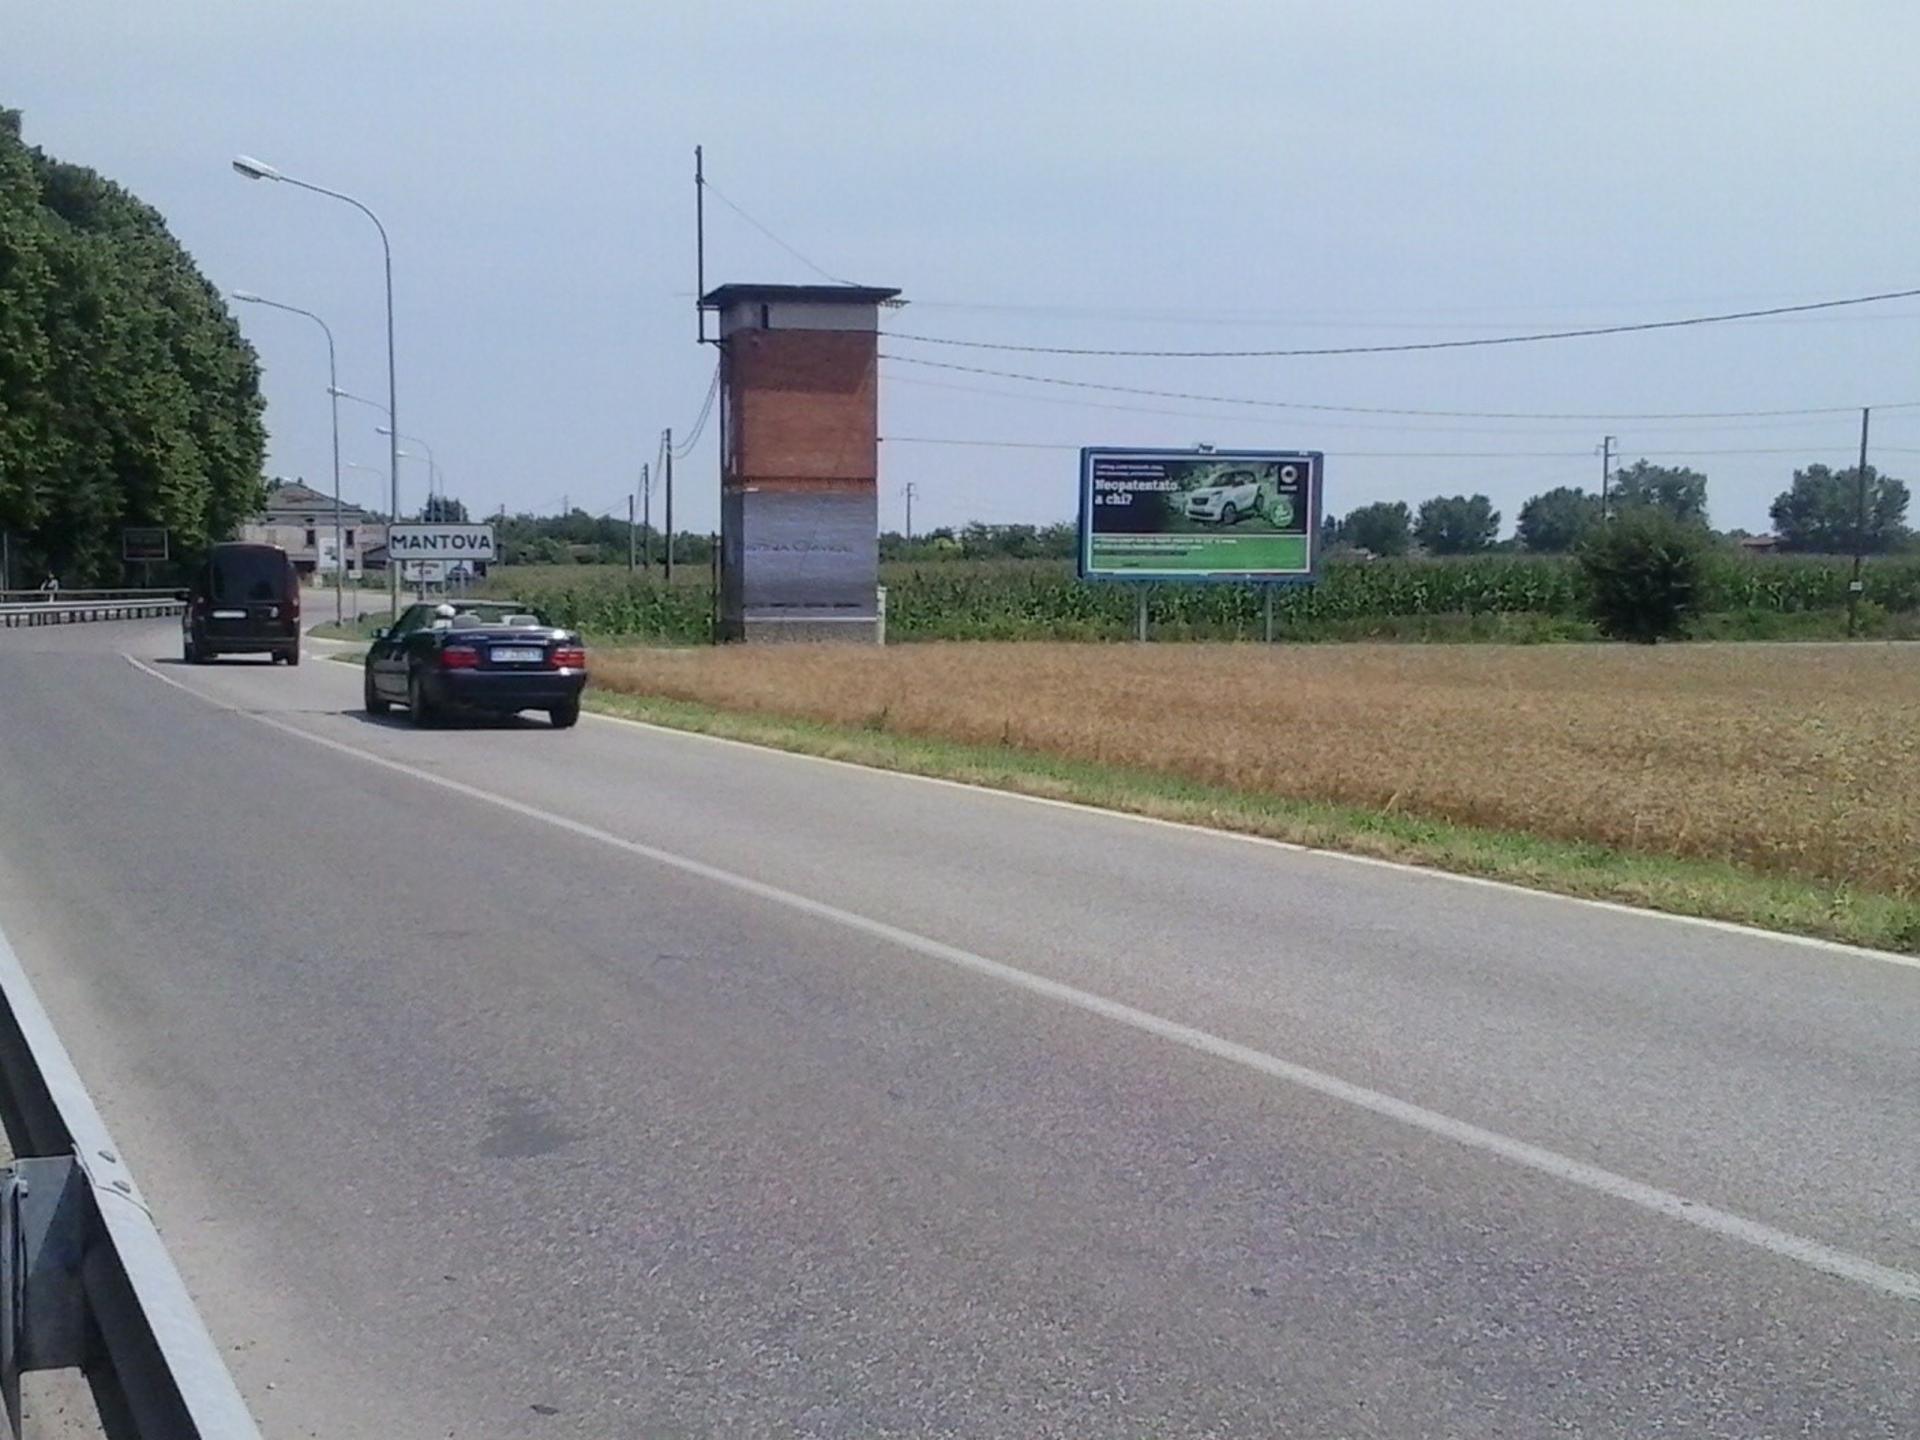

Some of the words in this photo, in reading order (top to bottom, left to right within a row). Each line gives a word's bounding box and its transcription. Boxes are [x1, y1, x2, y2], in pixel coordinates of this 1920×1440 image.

[1095, 495, 1104, 505] a
[1105, 493, 1133, 506] chi?
[391, 534, 491, 550] MANTOVA
